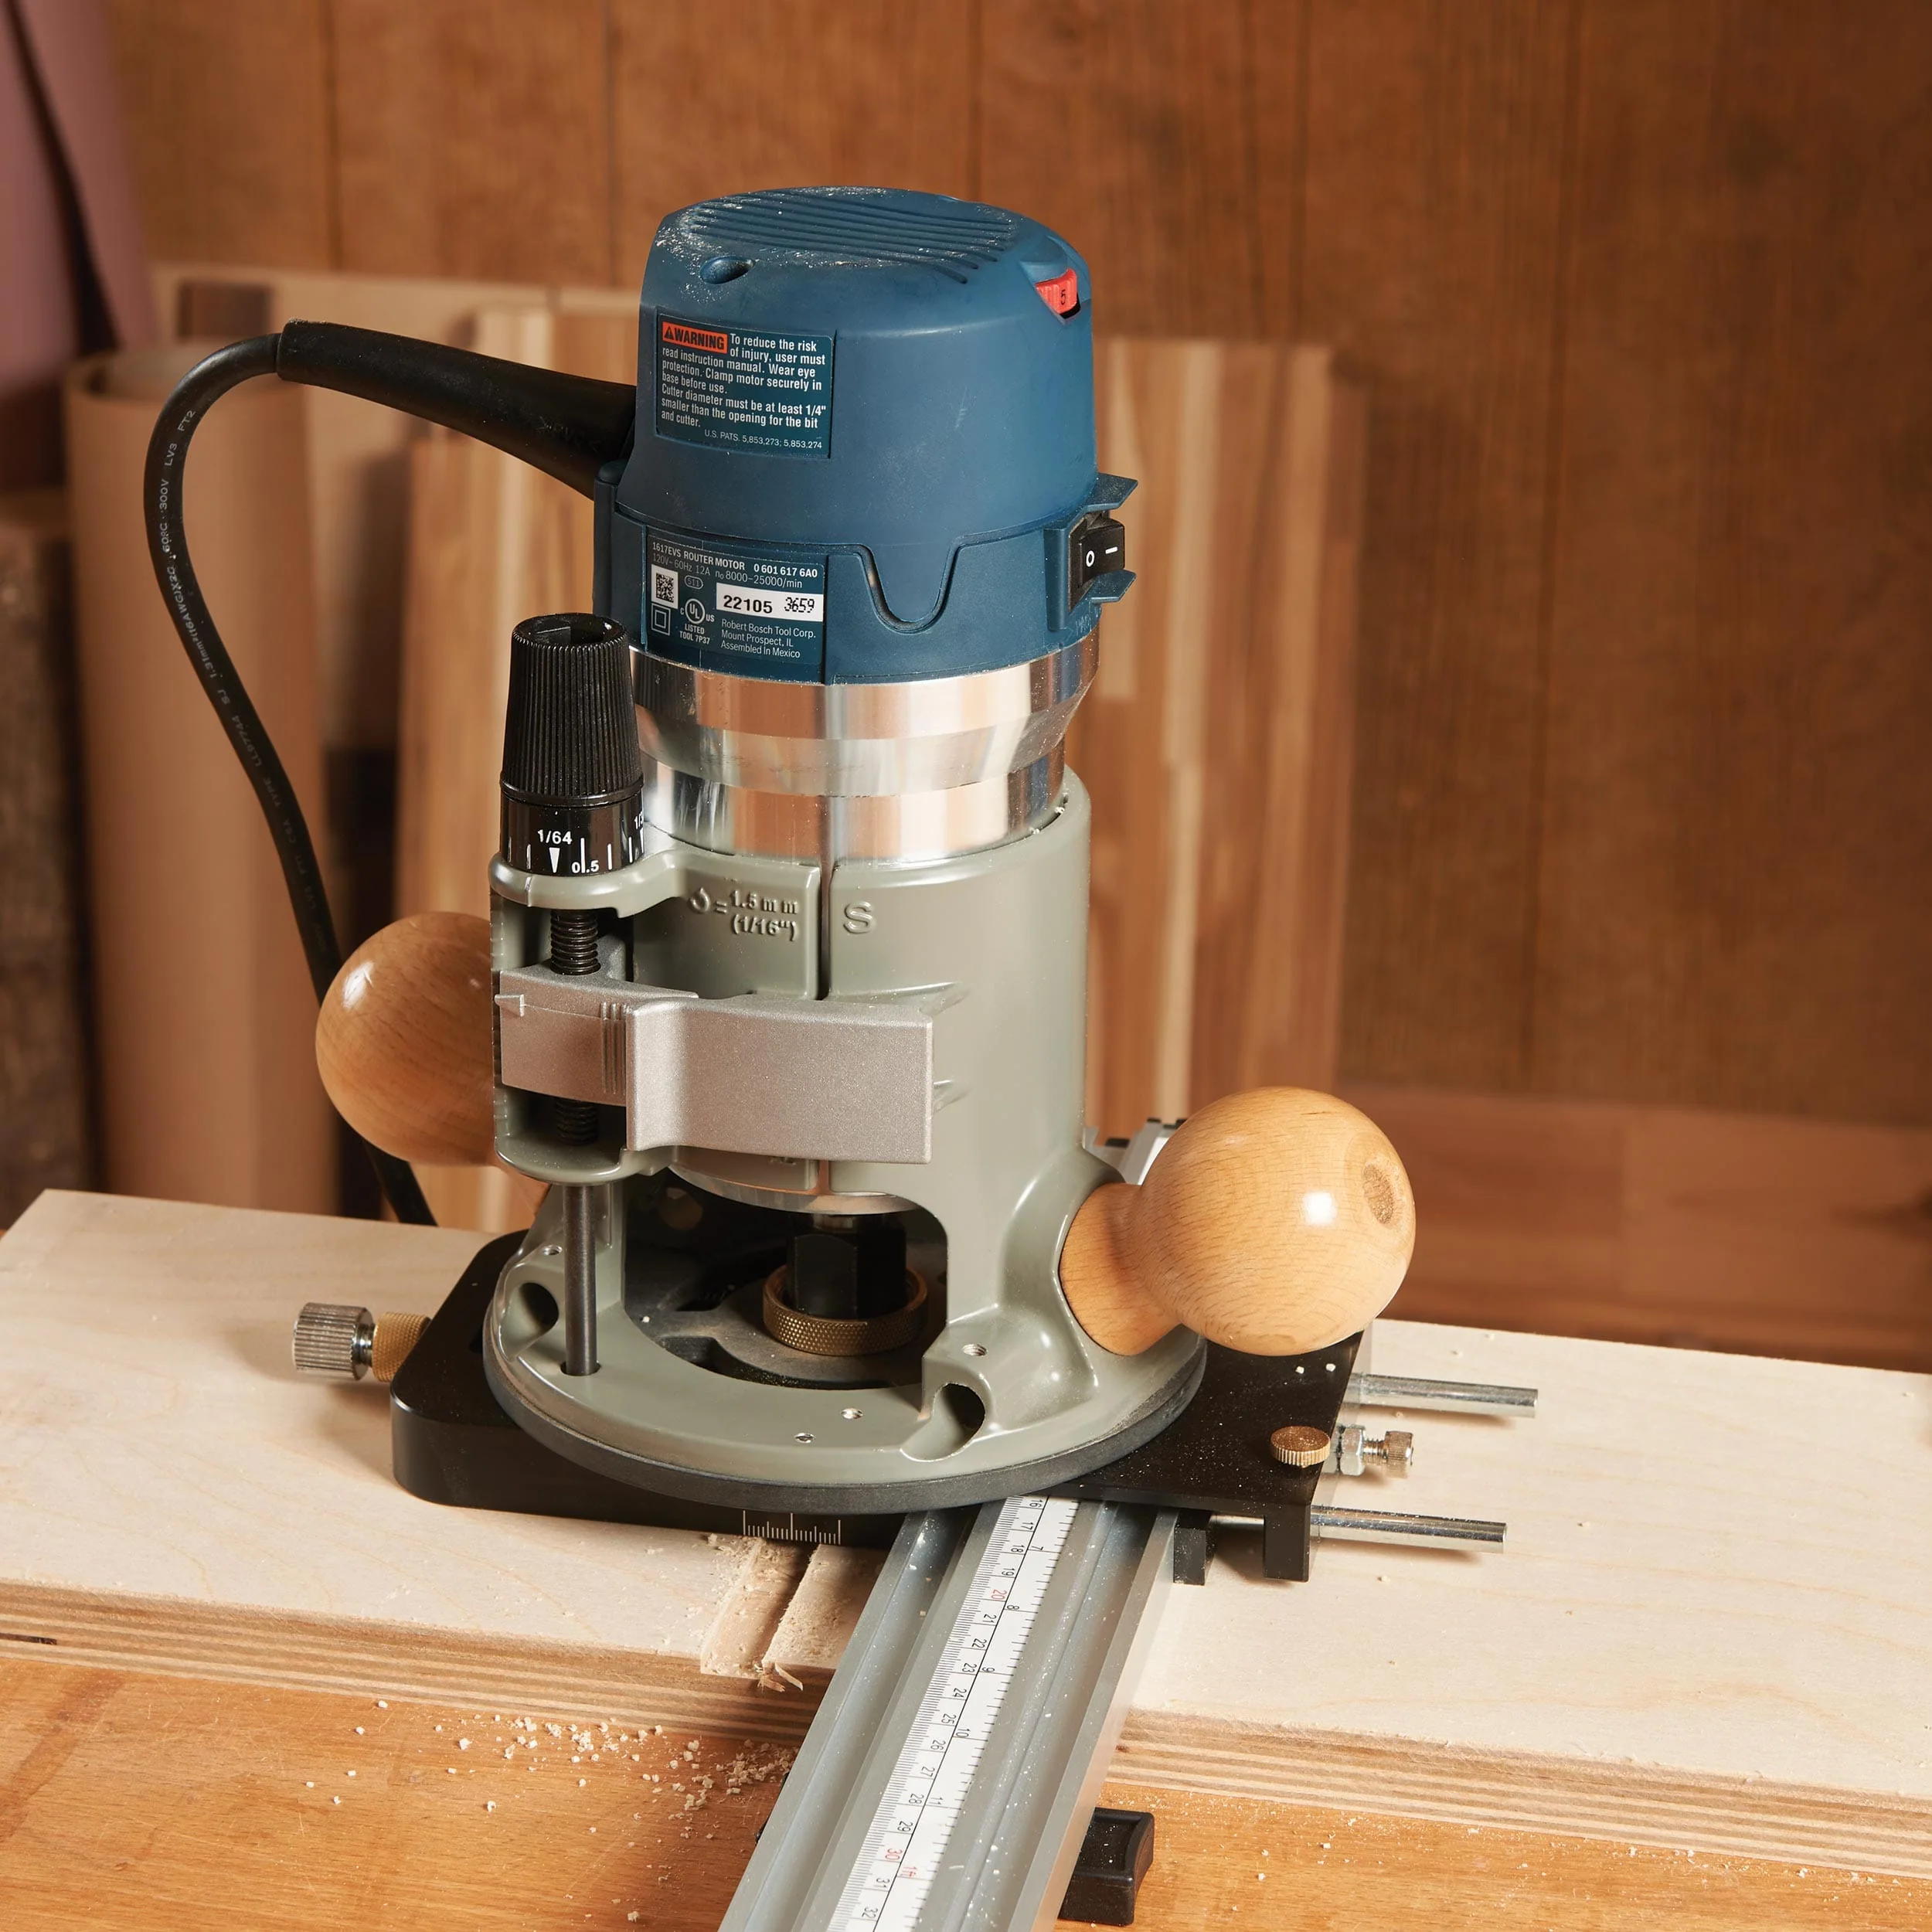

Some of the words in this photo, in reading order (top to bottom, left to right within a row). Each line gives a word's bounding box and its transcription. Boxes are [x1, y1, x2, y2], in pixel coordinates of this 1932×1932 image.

[1060, 289, 1066, 305] 5
[675, 328, 724, 349] WARNING
[730, 333, 740, 345] To
[743, 337, 776, 349] reduce
[779, 339, 794, 351] the
[798, 340, 817, 352] risk
[730, 347, 739, 357] of
[742, 348, 771, 363] injury,
[776, 353, 798, 363] user
[801, 354, 825, 365] must
[662, 348, 679, 359] read
[681, 349, 723, 368] instruction
[726, 360, 765, 373] manual.
[768, 363, 794, 376] Wear
[798, 368, 815, 379] eye
[662, 360, 702, 377] protection.
[706, 368, 733, 383] Clamp
[736, 374, 764, 386] motor
[767, 378, 808, 392] securely
[812, 379, 822, 390] in
[662, 371, 679, 384] base
[682, 376, 706, 389] before
[709, 383, 728, 394] use.
[662, 383, 683, 398] Cutter
[685, 389, 723, 406] diameter
[726, 399, 748, 410] must
[751, 400, 762, 411] be
[765, 402, 775, 413] at
[778, 403, 802, 414] least
[805, 405, 826, 416] 1/4"
[662, 397, 689, 412] smaller
[692, 403, 709, 416] than
[713, 407, 726, 419] the
[729, 412, 767, 427] opening
[770, 414, 783, 426] for
[785, 416, 801, 427] the
[805, 417, 818, 428] bit
[662, 411, 674, 421] and
[676, 414, 700, 427] cutter.
[165, 444, 178, 466] LV3
[177, 410, 196, 431] FT2
[705, 429, 718, 439] U.S.
[720, 431, 740, 442] PATS.
[652, 542, 682, 558] 1617EVS
[683, 550, 714, 566] ROUTER
[716, 558, 745, 570] MOTOR
[761, 565, 778, 574] 601
[781, 566, 798, 577] 617
[674, 560, 692, 572] 60Hz
[696, 566, 711, 575] 12A
[723, 595, 773, 614] 22105
[784, 597, 815, 614] 3659
[685, 623, 705, 634] LISTED
[722, 618, 747, 631] Robert
[748, 623, 773, 634] Bosch
[774, 626, 791, 636] Tool
[793, 628, 816, 640] Corp.
[680, 631, 694, 641] TOOL
[721, 629, 745, 641] Mount
[787, 638, 794, 648] IL
[720, 640, 762, 655] Assembled
[773, 648, 801, 658] Mexico
[537, 829, 572, 845] 1/64
[842, 900, 876, 934] S
[1021, 1522, 1034, 1530] 17
[1011, 1545, 1025, 1553] 18
[1002, 1567, 1015, 1577] 19
[991, 1589, 1008, 1601] 20
[982, 1614, 997, 1624] 21
[971, 1638, 988, 1649] 22
[961, 1663, 978, 1674] 23
[952, 1688, 968, 1698] 24
[941, 1713, 957, 1725] 25
[955, 1728, 971, 1738] 10
[930, 1739, 946, 1751] 26
[920, 1766, 935, 1777] 27
[908, 1793, 924, 1805] 28
[929, 1796, 944, 1805] 11
[897, 1821, 913, 1832] 29
[884, 1848, 903, 1861] 30
[873, 1877, 890, 1889] 31
[861, 1906, 878, 1920] 32
